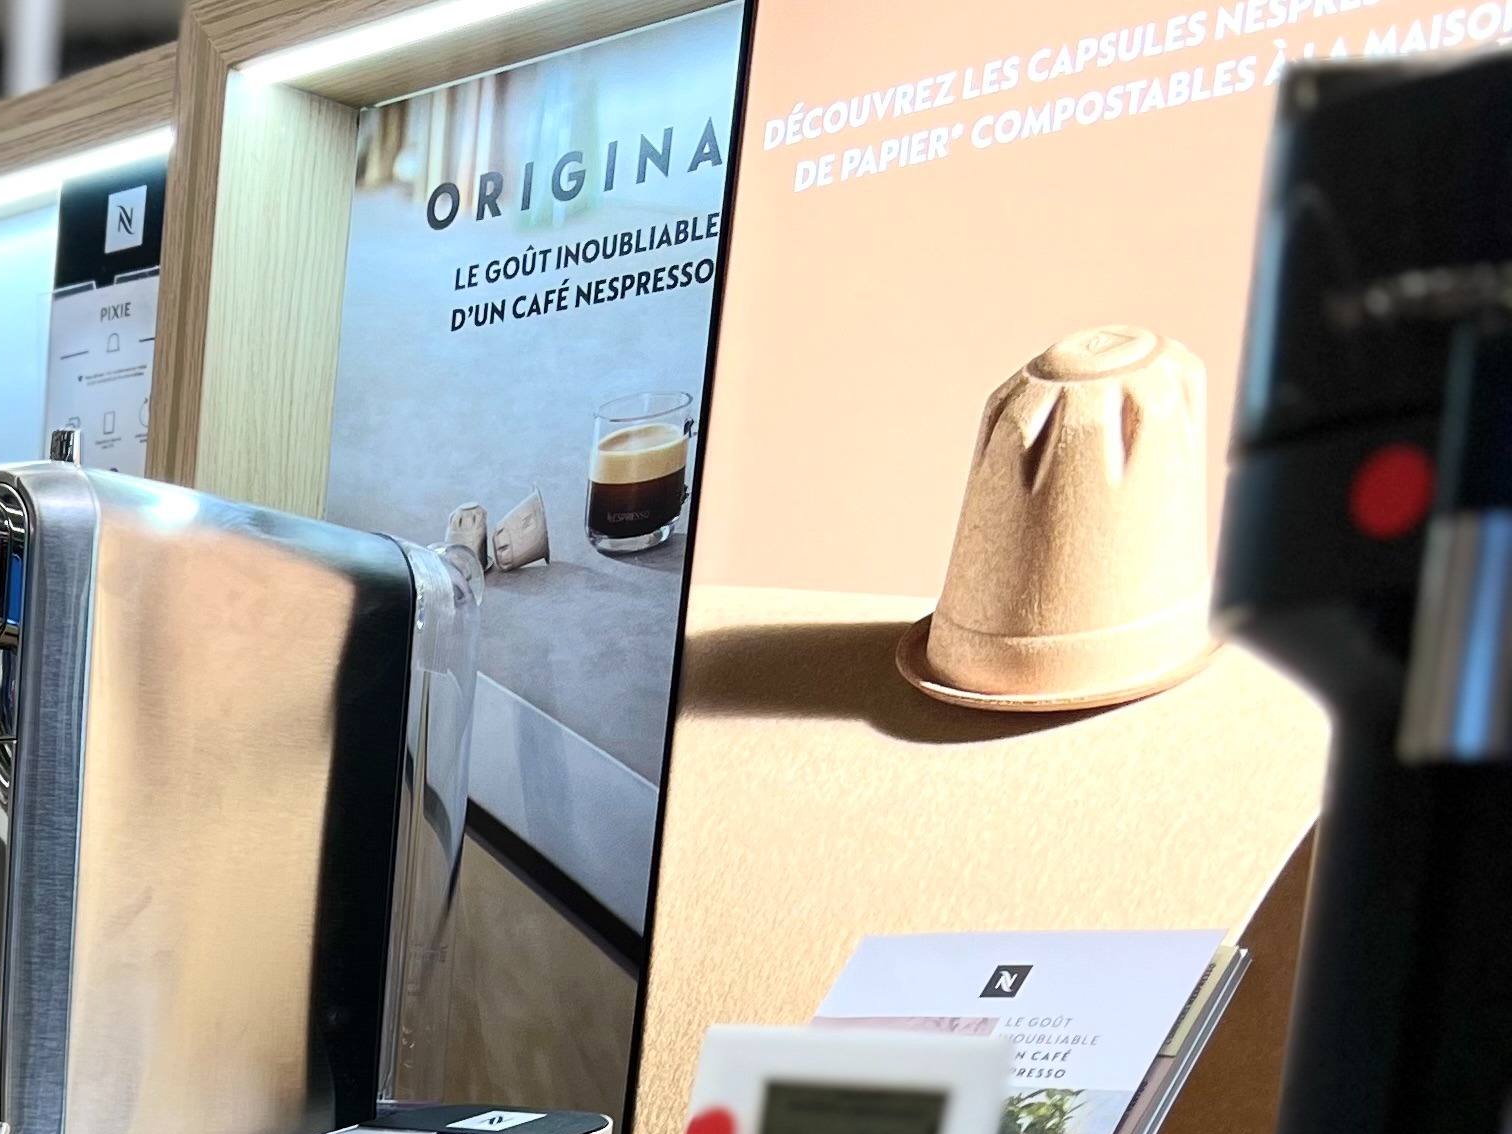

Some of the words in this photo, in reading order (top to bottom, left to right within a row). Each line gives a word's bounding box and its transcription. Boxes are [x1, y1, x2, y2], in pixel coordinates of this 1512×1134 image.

[763, 70, 957, 151] DÉCOUVREZ
[962, 55, 1021, 100] LES
[1026, 10, 1208, 83] CAPSULES
[1213, 0, 1382, 41] NESPR
[793, 153, 836, 193] DE
[970, 55, 1257, 149] COMPOSTABLES
[1263, 38, 1287, 87] À
[426, 116, 723, 231] ORIGINA
[454, 263, 480, 291] LE
[485, 245, 552, 284] GOÛT
[555, 212, 720, 270] INOUBLIABLE
[100, 301, 132, 323] PIXIE
[450, 299, 506, 332] D'UN
[511, 278, 570, 319] CAFÉ
[574, 258, 714, 309] NESPRESSO
[1005, 1016, 1025, 1028] LE
[1027, 1014, 1074, 1028] GOÛT
[1030, 1048, 1073, 1061] CAFÉ
